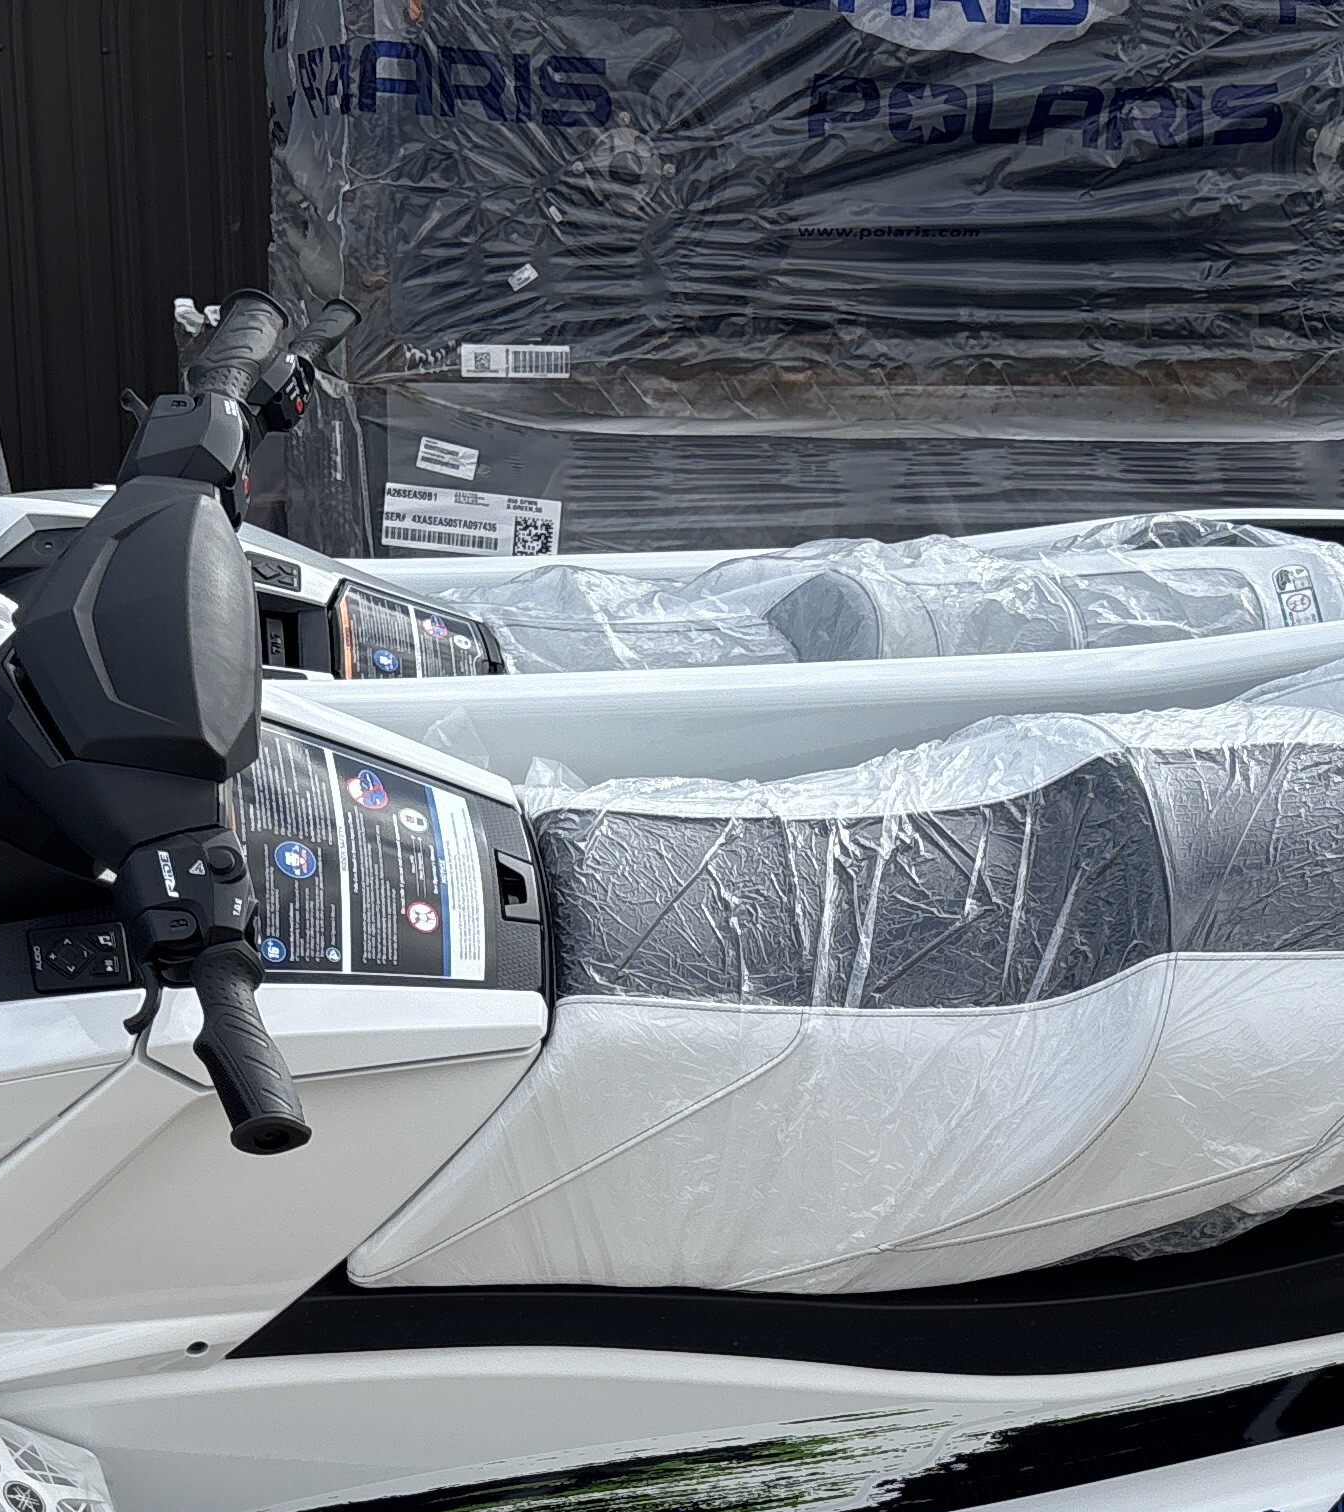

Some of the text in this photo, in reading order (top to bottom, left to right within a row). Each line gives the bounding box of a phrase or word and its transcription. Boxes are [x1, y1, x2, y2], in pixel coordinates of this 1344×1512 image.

[808, 75, 1284, 151] POLARIS
[797, 227, 981, 241] www.polaris.com
[32, 945, 44, 971] AUDIO
